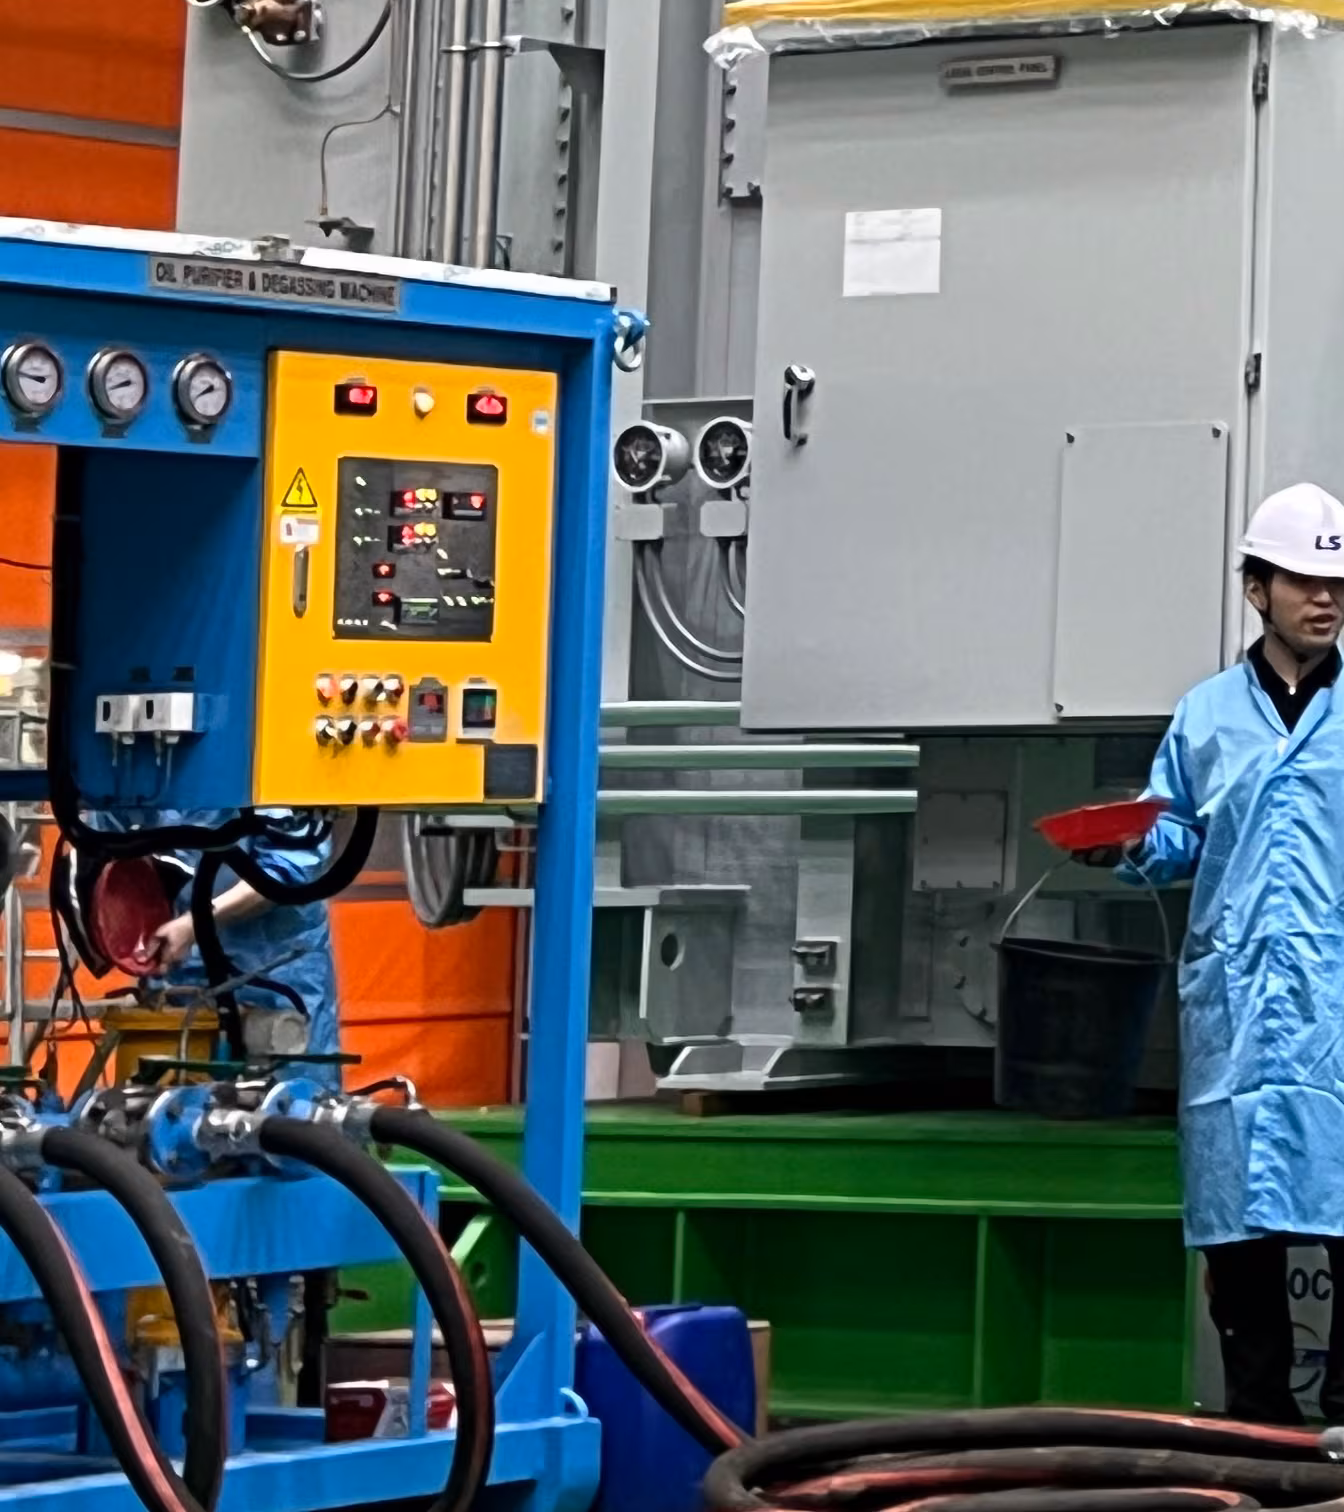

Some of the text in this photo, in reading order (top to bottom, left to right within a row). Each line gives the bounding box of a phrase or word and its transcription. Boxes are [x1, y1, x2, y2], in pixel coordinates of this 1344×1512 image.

[155, 261, 177, 283] OIL
[183, 264, 243, 290] PURIFIER
[261, 272, 335, 299] DEGASSING
[1314, 535, 1342, 551] LS
